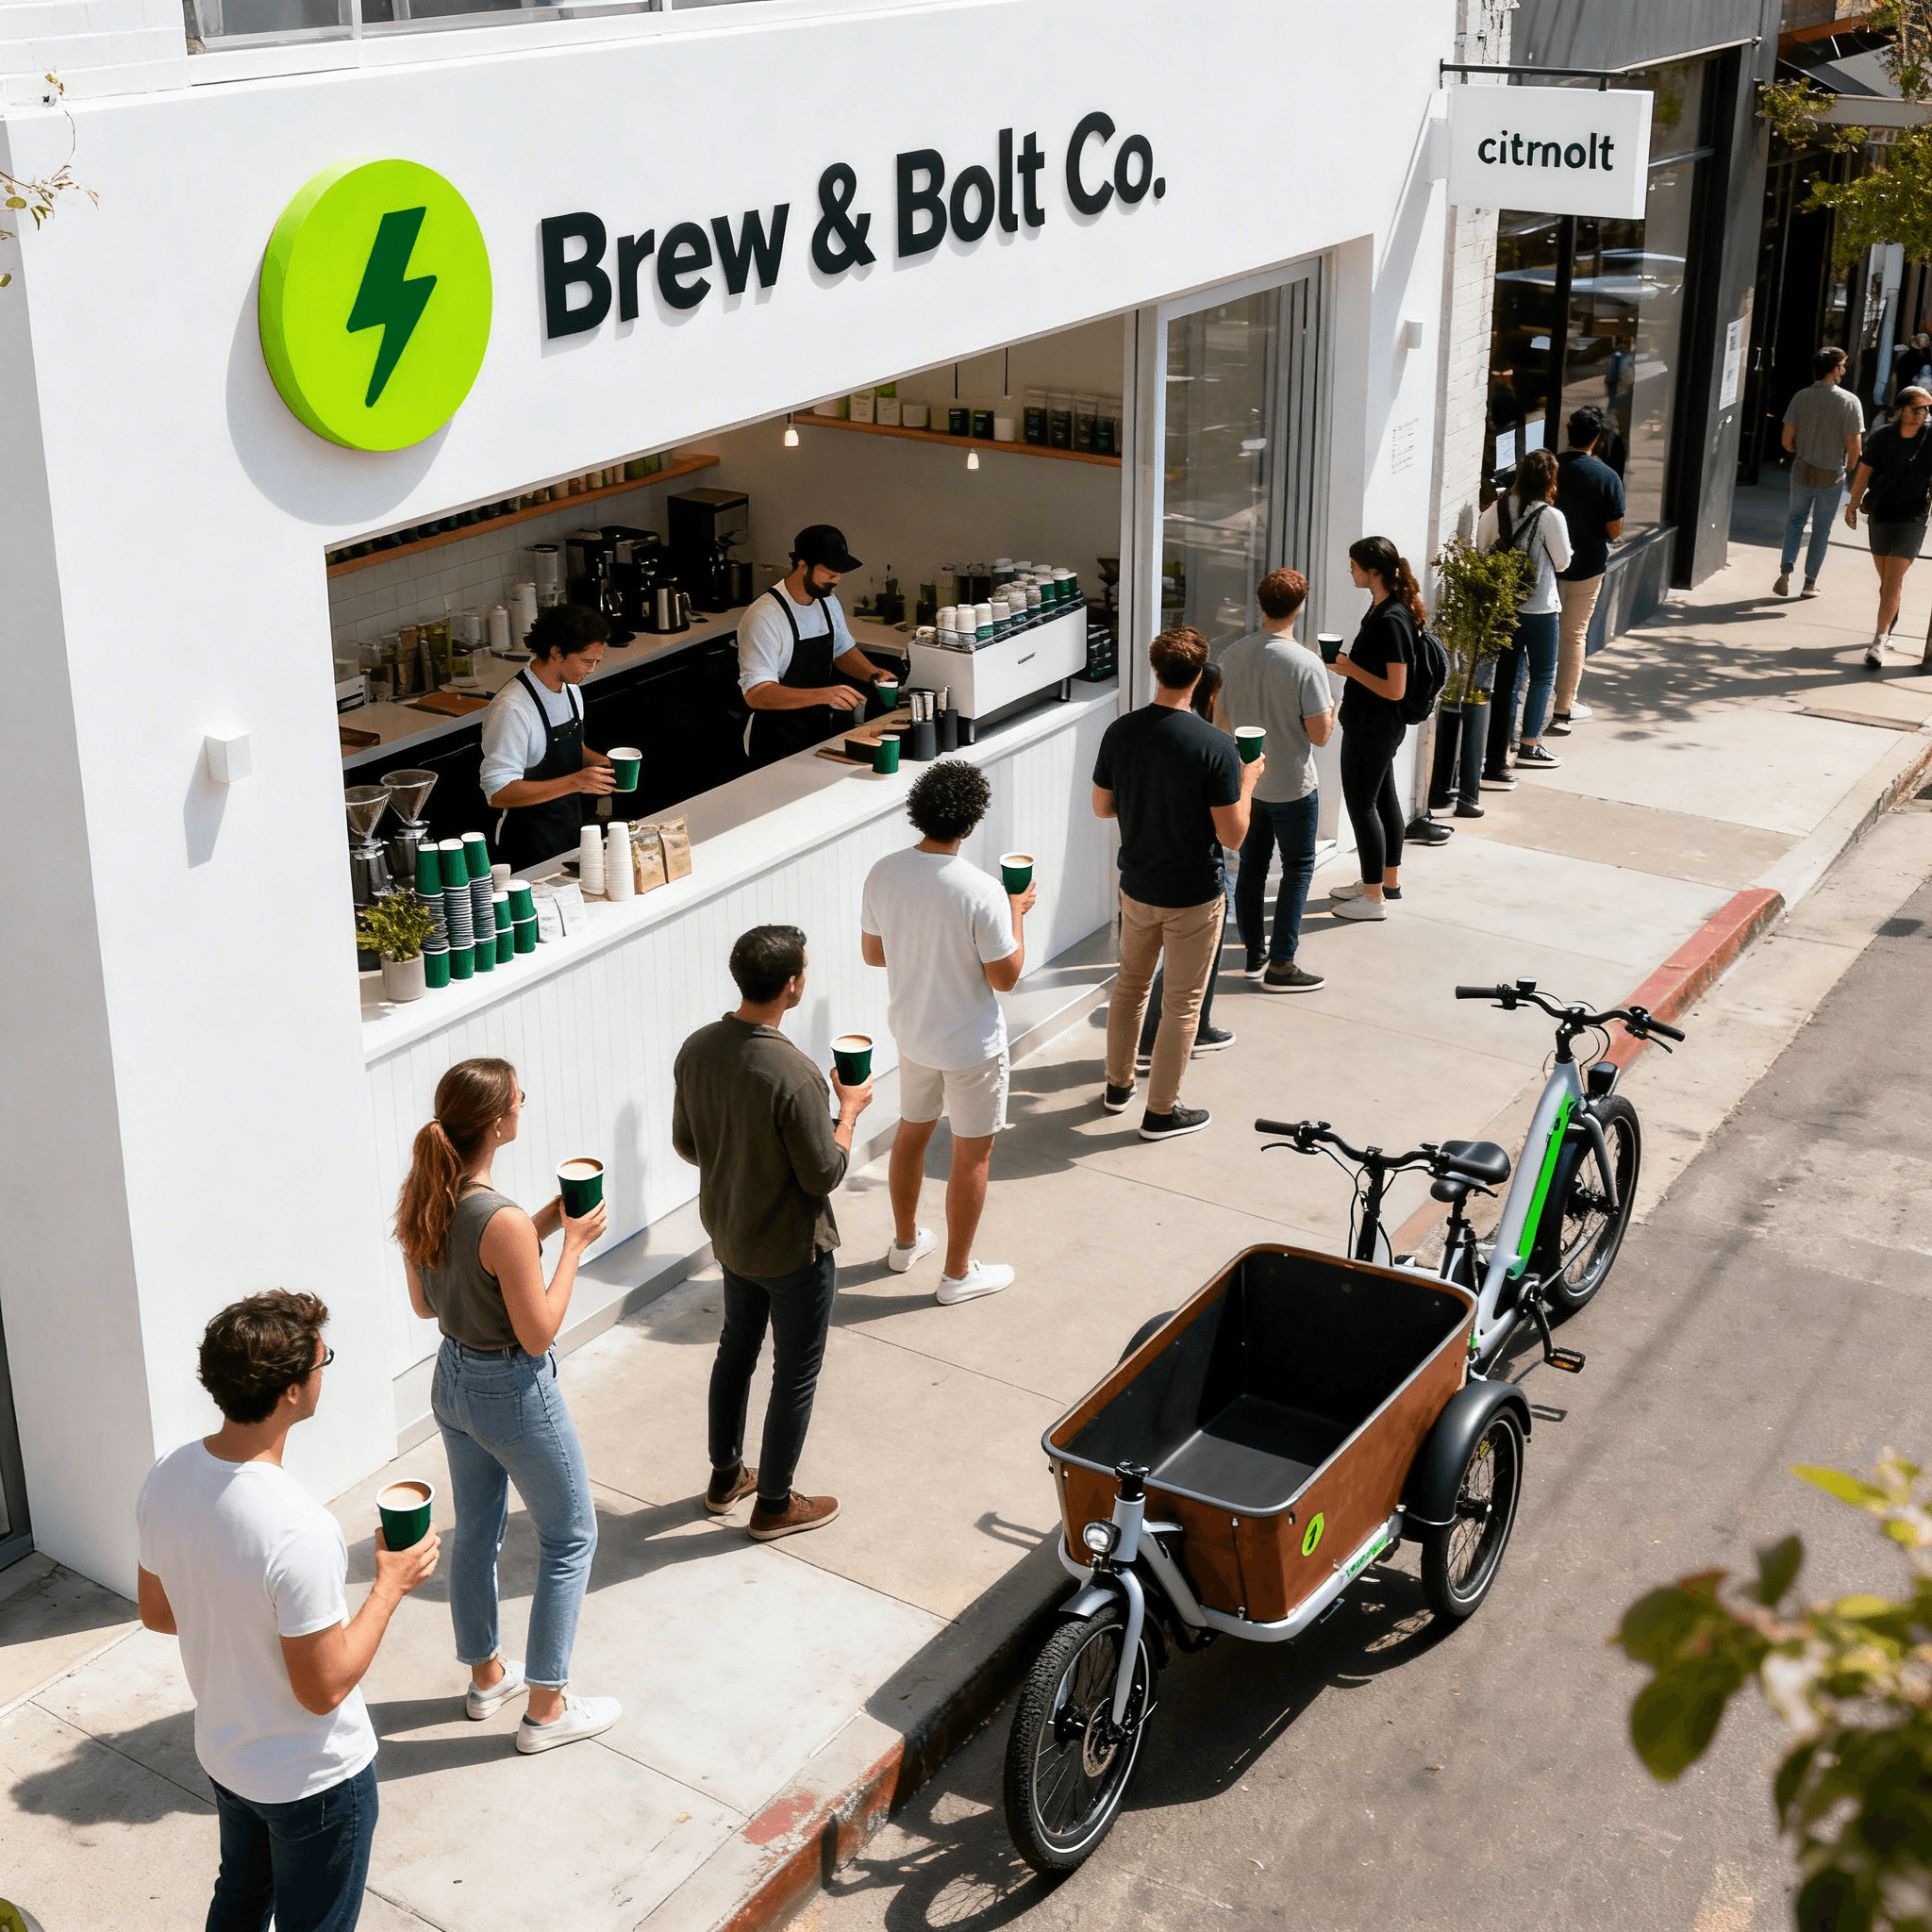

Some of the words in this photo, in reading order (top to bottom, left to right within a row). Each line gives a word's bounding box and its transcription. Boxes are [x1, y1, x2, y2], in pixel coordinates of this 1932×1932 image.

[541, 202, 791, 341] Brew
[810, 162, 877, 275] &
[896, 127, 1045, 258] Bolt
[1065, 111, 1167, 216] Co.
